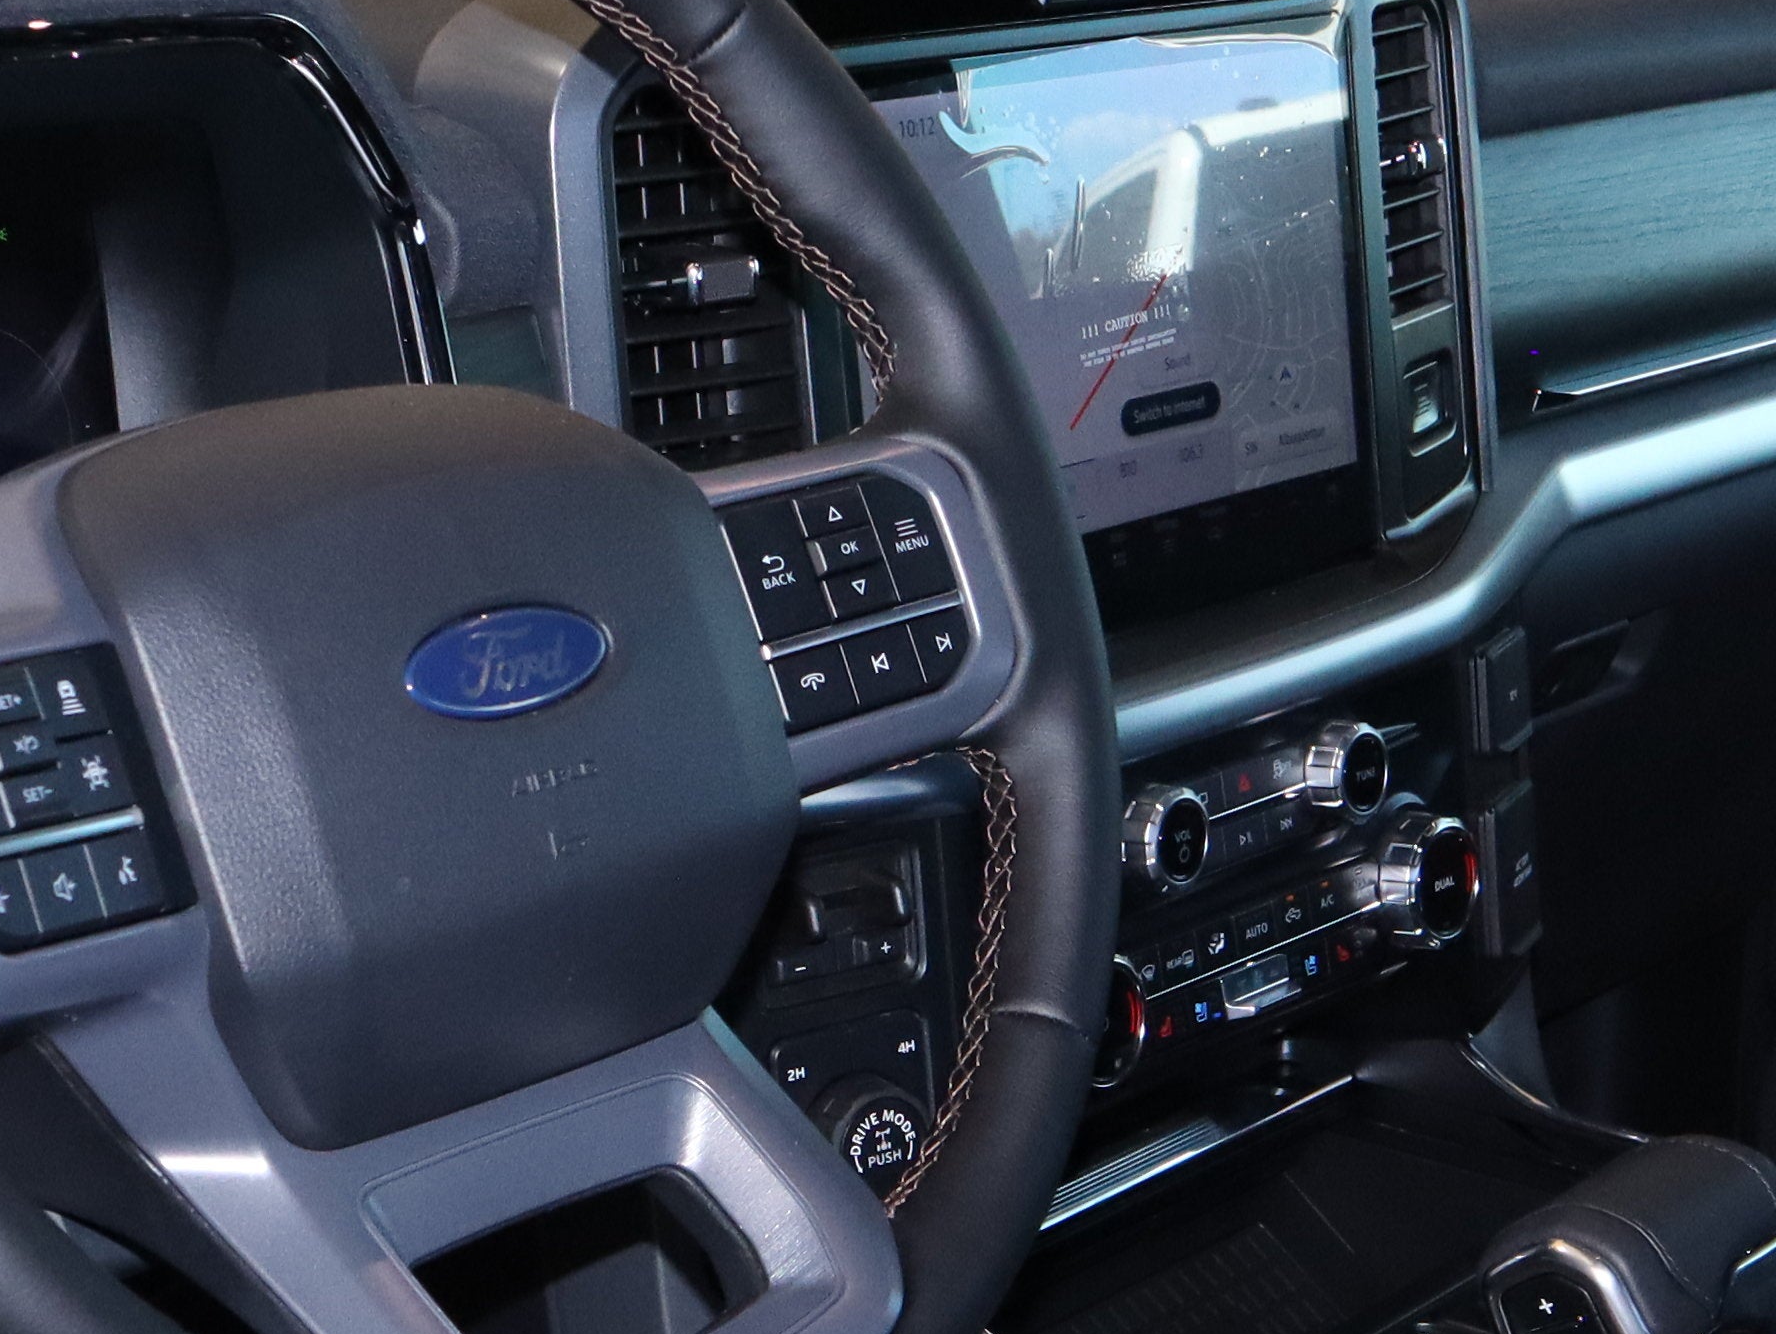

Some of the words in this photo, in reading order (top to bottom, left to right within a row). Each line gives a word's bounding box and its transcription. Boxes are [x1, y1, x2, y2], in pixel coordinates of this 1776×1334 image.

[1104, 310, 1148, 333] CAUTION
[840, 540, 860, 555] OK
[895, 535, 930, 554] MENU
[761, 571, 797, 590] BACK
[1434, 875, 1455, 892] DUAL
[1320, 894, 1335, 909] A/C
[1245, 923, 1268, 940] AUTO
[897, 1039, 916, 1054] 4H
[787, 1066, 806, 1082] 2H
[849, 1112, 879, 1156] DRIVE
[882, 1109, 916, 1142] MODE
[867, 1149, 902, 1168] PUSH
